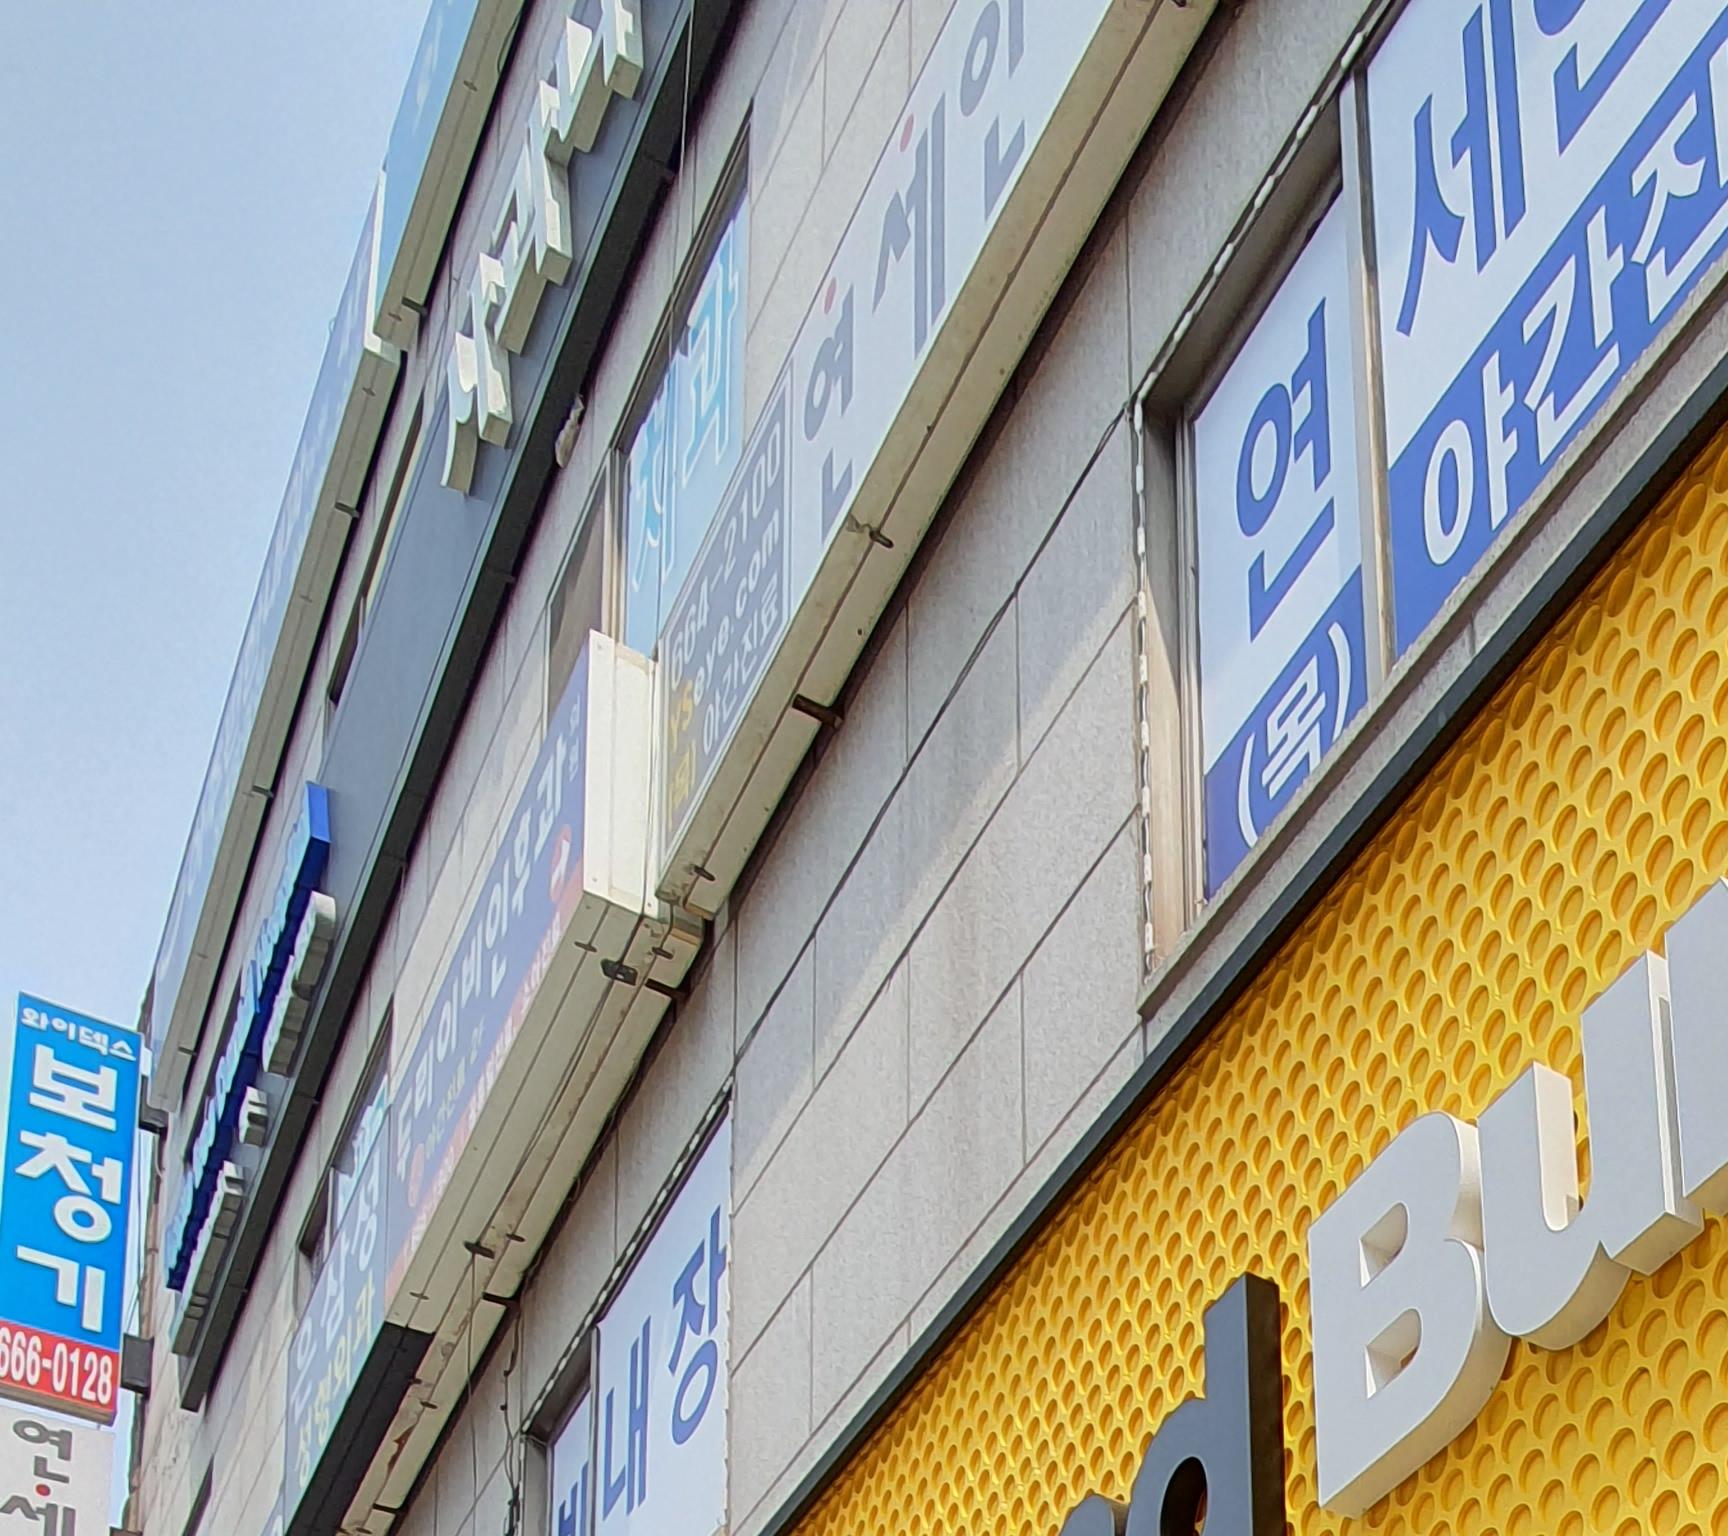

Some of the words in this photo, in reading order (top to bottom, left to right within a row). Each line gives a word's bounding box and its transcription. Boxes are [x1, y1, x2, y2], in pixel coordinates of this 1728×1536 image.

[671, 419, 781, 692] 664-2100
[703, 572, 779, 755] 야간진료
[1238, 621, 1352, 848] (목)
[20, 1006, 136, 1062] 와이덱스
[15, 1043, 123, 1333] 보청기
[0, 1326, 112, 1406] 666-0128
